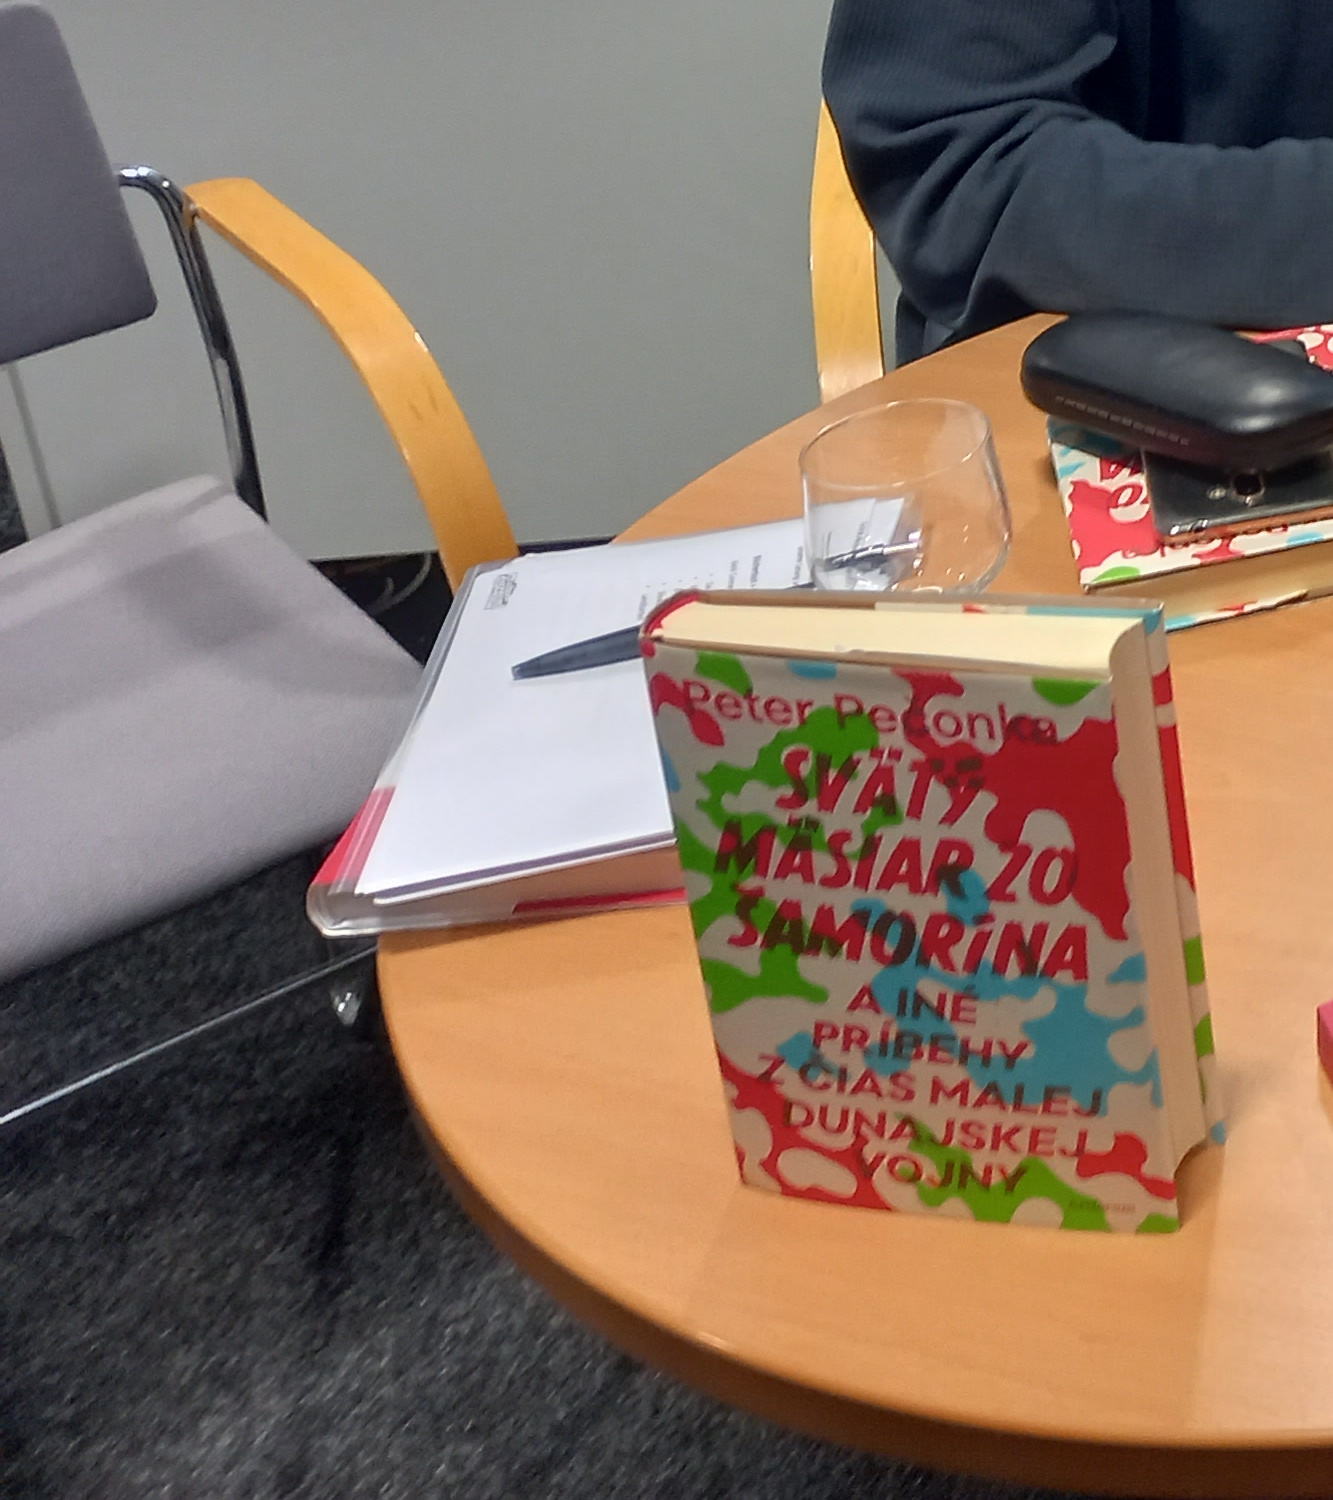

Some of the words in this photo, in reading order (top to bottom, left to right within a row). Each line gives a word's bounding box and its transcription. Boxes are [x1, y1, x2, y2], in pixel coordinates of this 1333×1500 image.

[684, 679, 814, 726] Peter
[713, 813, 974, 897] MÄSIAR
[847, 984, 881, 1015] A
[896, 984, 980, 1024] INÉ
[812, 1018, 1030, 1070] PRÍBEHY
[757, 1052, 785, 1086] Z
[798, 1054, 917, 1102] ČIAS
[929, 1075, 1104, 1118] MALEJ
[784, 1100, 1088, 1158] DUNAJSKEJ
[857, 1150, 1029, 1193] VOJNY
